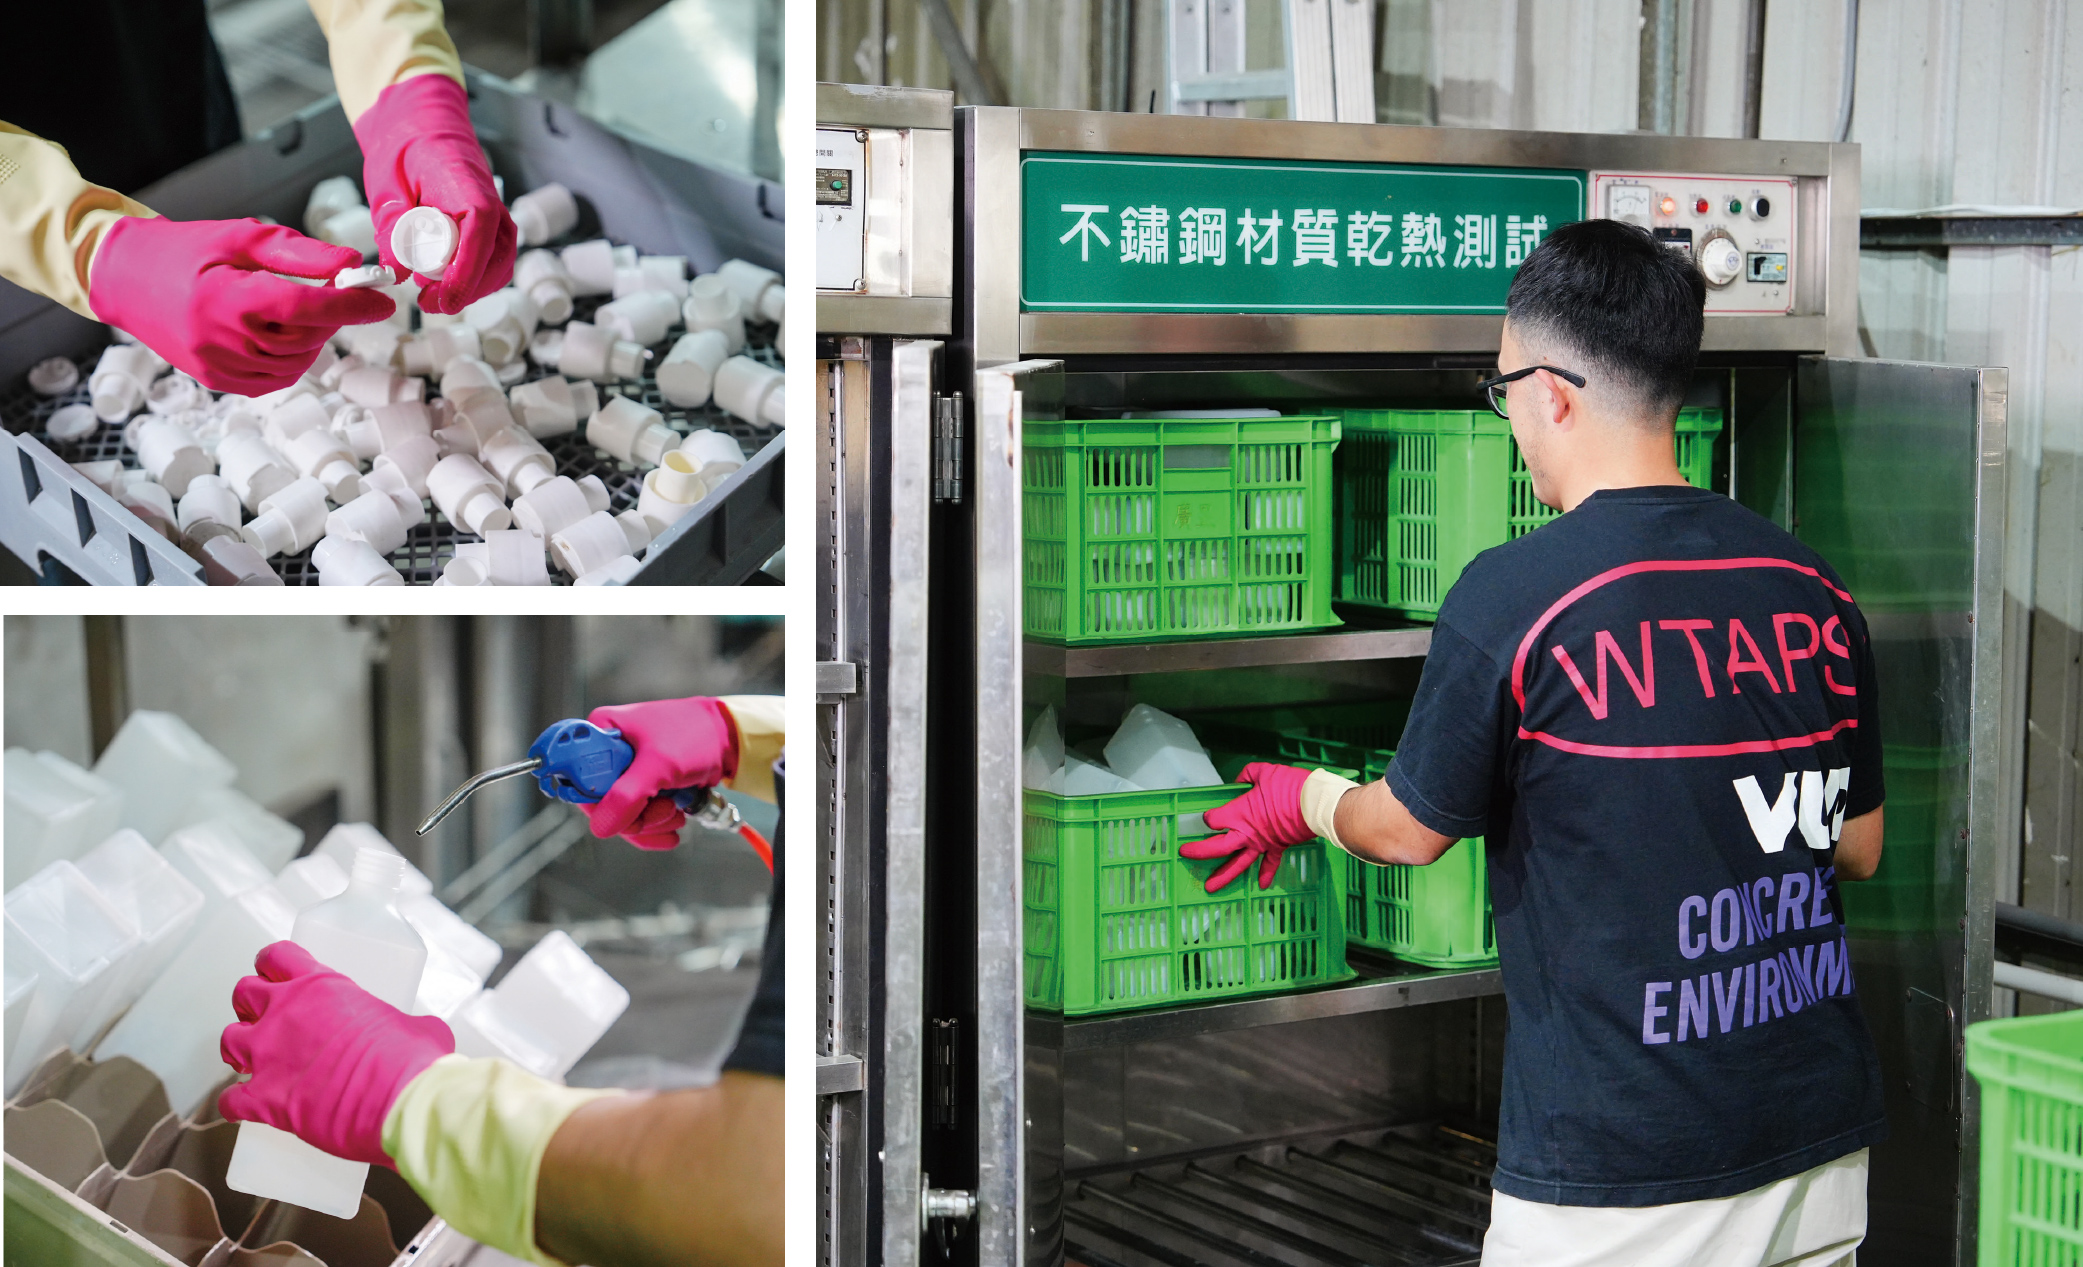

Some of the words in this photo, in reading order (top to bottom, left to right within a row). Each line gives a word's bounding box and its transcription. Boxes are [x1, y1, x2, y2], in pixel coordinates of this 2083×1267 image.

[1059, 203, 1548, 269] 不鏽鋼材質乾熱測試
[1551, 612, 1857, 720] WTAPS
[1678, 865, 1846, 960] CONCRE
[1642, 936, 1856, 1045] ENVIRONM
